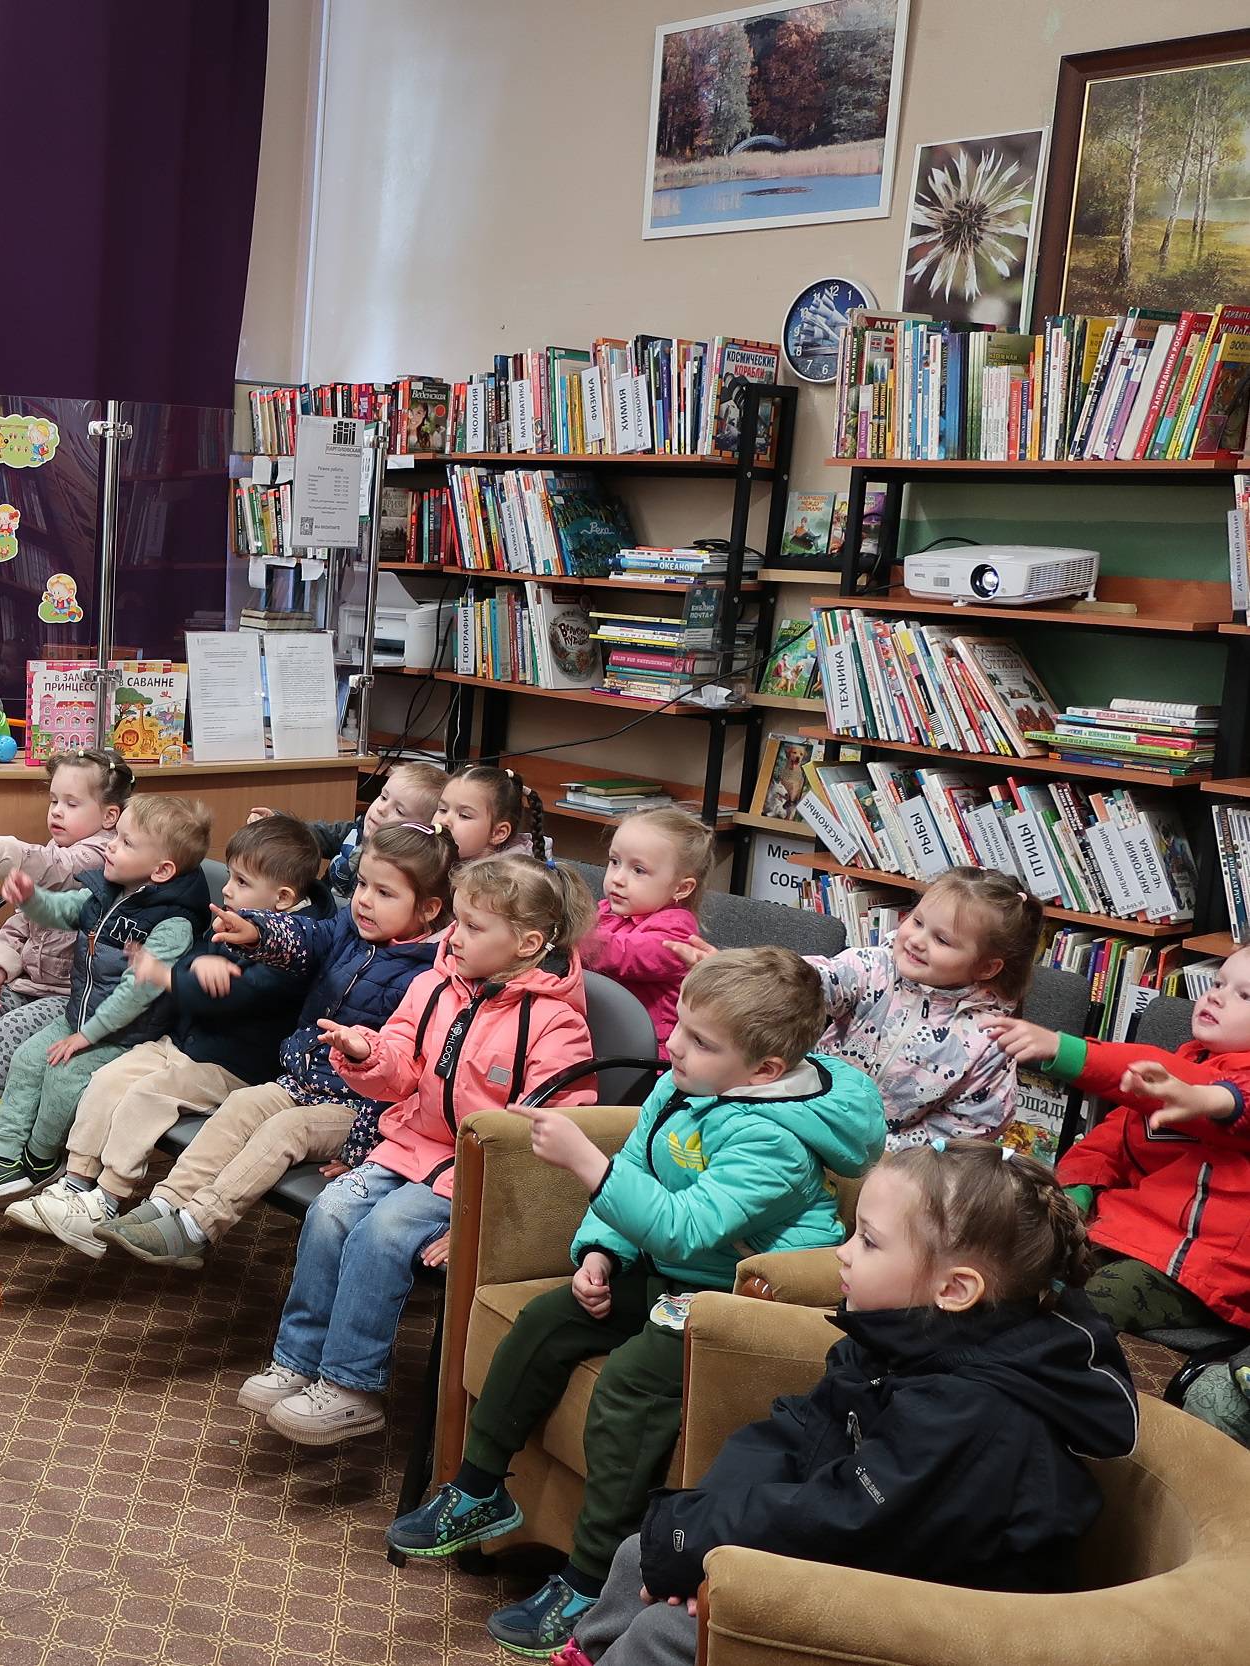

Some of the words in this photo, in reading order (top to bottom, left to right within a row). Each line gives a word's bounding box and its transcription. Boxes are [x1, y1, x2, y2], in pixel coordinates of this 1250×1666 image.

[829, 285, 839, 297] 12
[726, 350, 776, 368] КОСМИЧЕСКИЕ
[733, 365, 767, 377] КОРАБЛИ
[806, 359, 813, 371] 7
[822, 364, 829, 374] 6
[1152, 354, 1175, 410] ЗАПОВЕДНИКИ
[1172, 319, 1187, 351] РОССИИ
[519, 382, 527, 438] МАТЕМАТИКА
[589, 377, 598, 421] ФИЗИКА
[619, 388, 628, 431] ХИМИЯ
[634, 379, 643, 438] АСТРОНОМИЯ
[45, 683, 96, 692] ПРИНЦЕСС
[127, 678, 174, 687] САВАННЕ
[838, 650, 850, 712] ТЕХНИКА
[803, 798, 846, 849] НАСЕКОМЫЕ
[910, 812, 934, 855] РЫБЫ
[1017, 823, 1045, 877] ПТИЦЫ
[1098, 827, 1131, 898] МЛЕКОПИТАЮЩИЕ
[1124, 840, 1151, 894] АНАТОМИЯ
[1138, 838, 1162, 889] ЧЕЛОВЕКА
